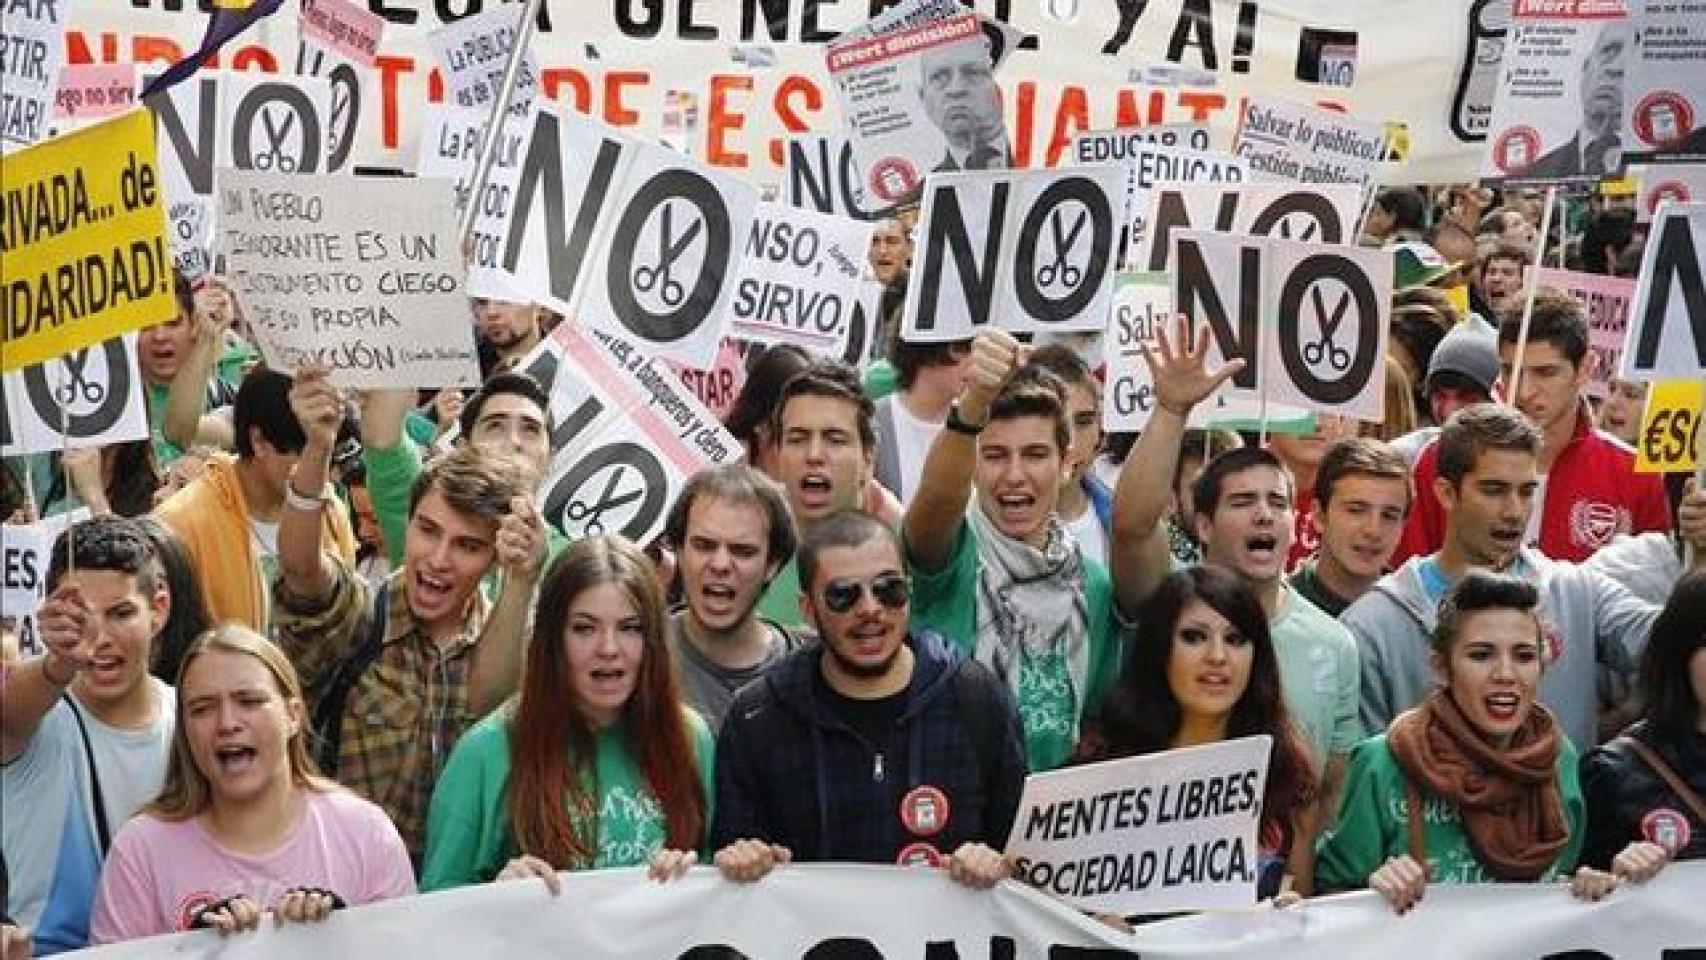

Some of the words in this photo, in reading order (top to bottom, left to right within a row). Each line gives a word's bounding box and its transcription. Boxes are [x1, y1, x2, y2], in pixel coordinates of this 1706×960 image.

[143, 74, 321, 195] NO
[121, 149, 157, 213] de
[250, 187, 322, 223] PUEBLO
[226, 229, 344, 262] IGNORANTE
[354, 230, 389, 262] ES
[400, 232, 437, 262] UN
[502, 109, 731, 344] NO
[914, 176, 1113, 330] NO
[377, 268, 458, 295] CIEGO
[734, 277, 845, 335] SIRVO.
[310, 304, 401, 332] PROPIA
[1176, 238, 1380, 405] NO
[1024, 787, 1152, 842] MENTES
[1156, 768, 1261, 825] LIBRES,
[1010, 849, 1158, 897] SOCIEDAD
[1161, 837, 1256, 887] LAICA.
